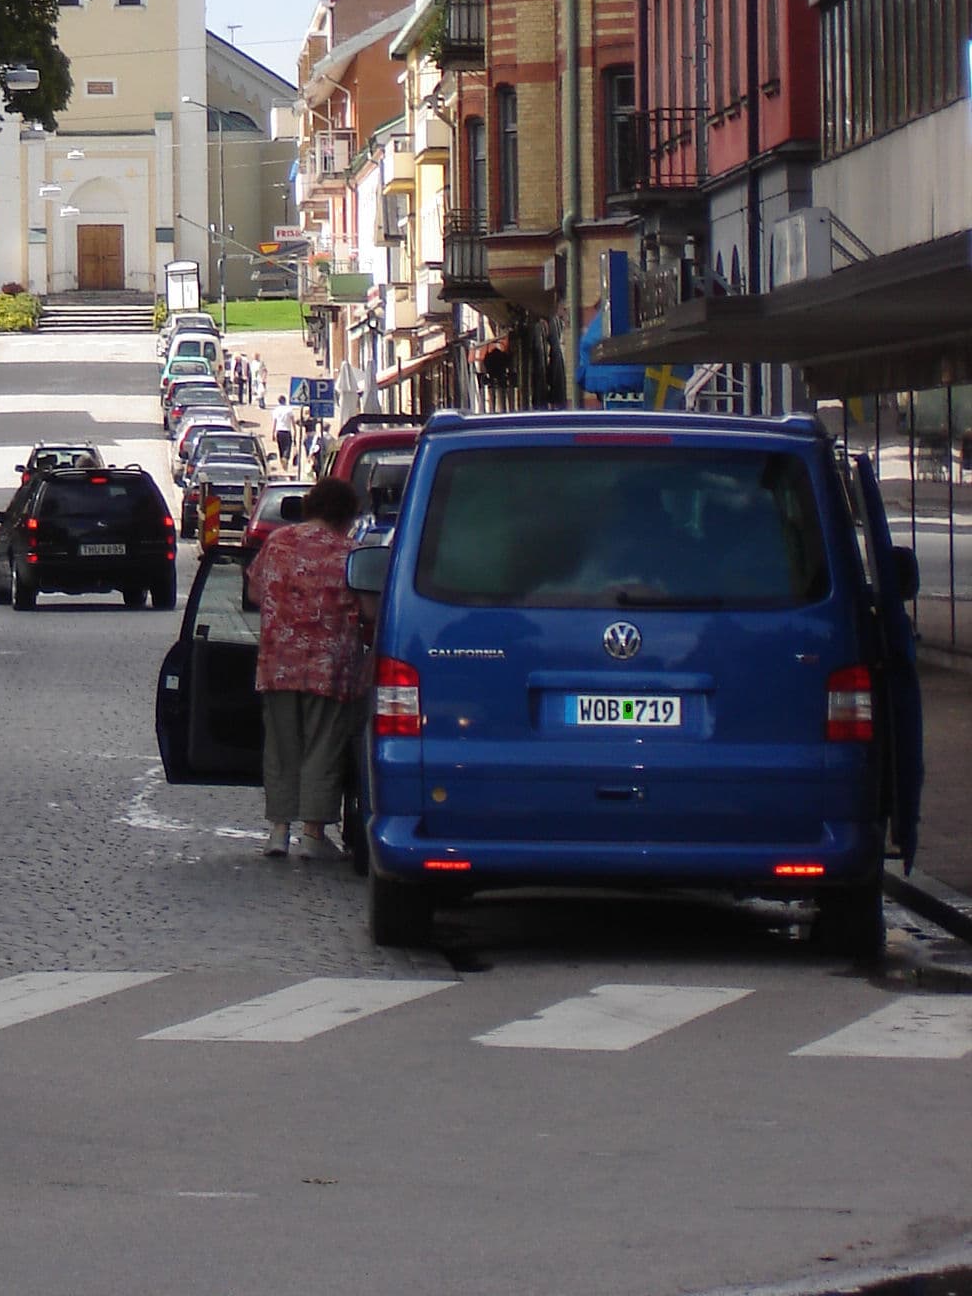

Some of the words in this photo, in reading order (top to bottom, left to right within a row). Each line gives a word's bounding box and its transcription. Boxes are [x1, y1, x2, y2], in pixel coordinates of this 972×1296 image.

[316, 381, 329, 399] P
[428, 649, 505, 658] CALIFORNIA
[580, 698, 620, 721] WOB
[635, 700, 674, 723] 719
